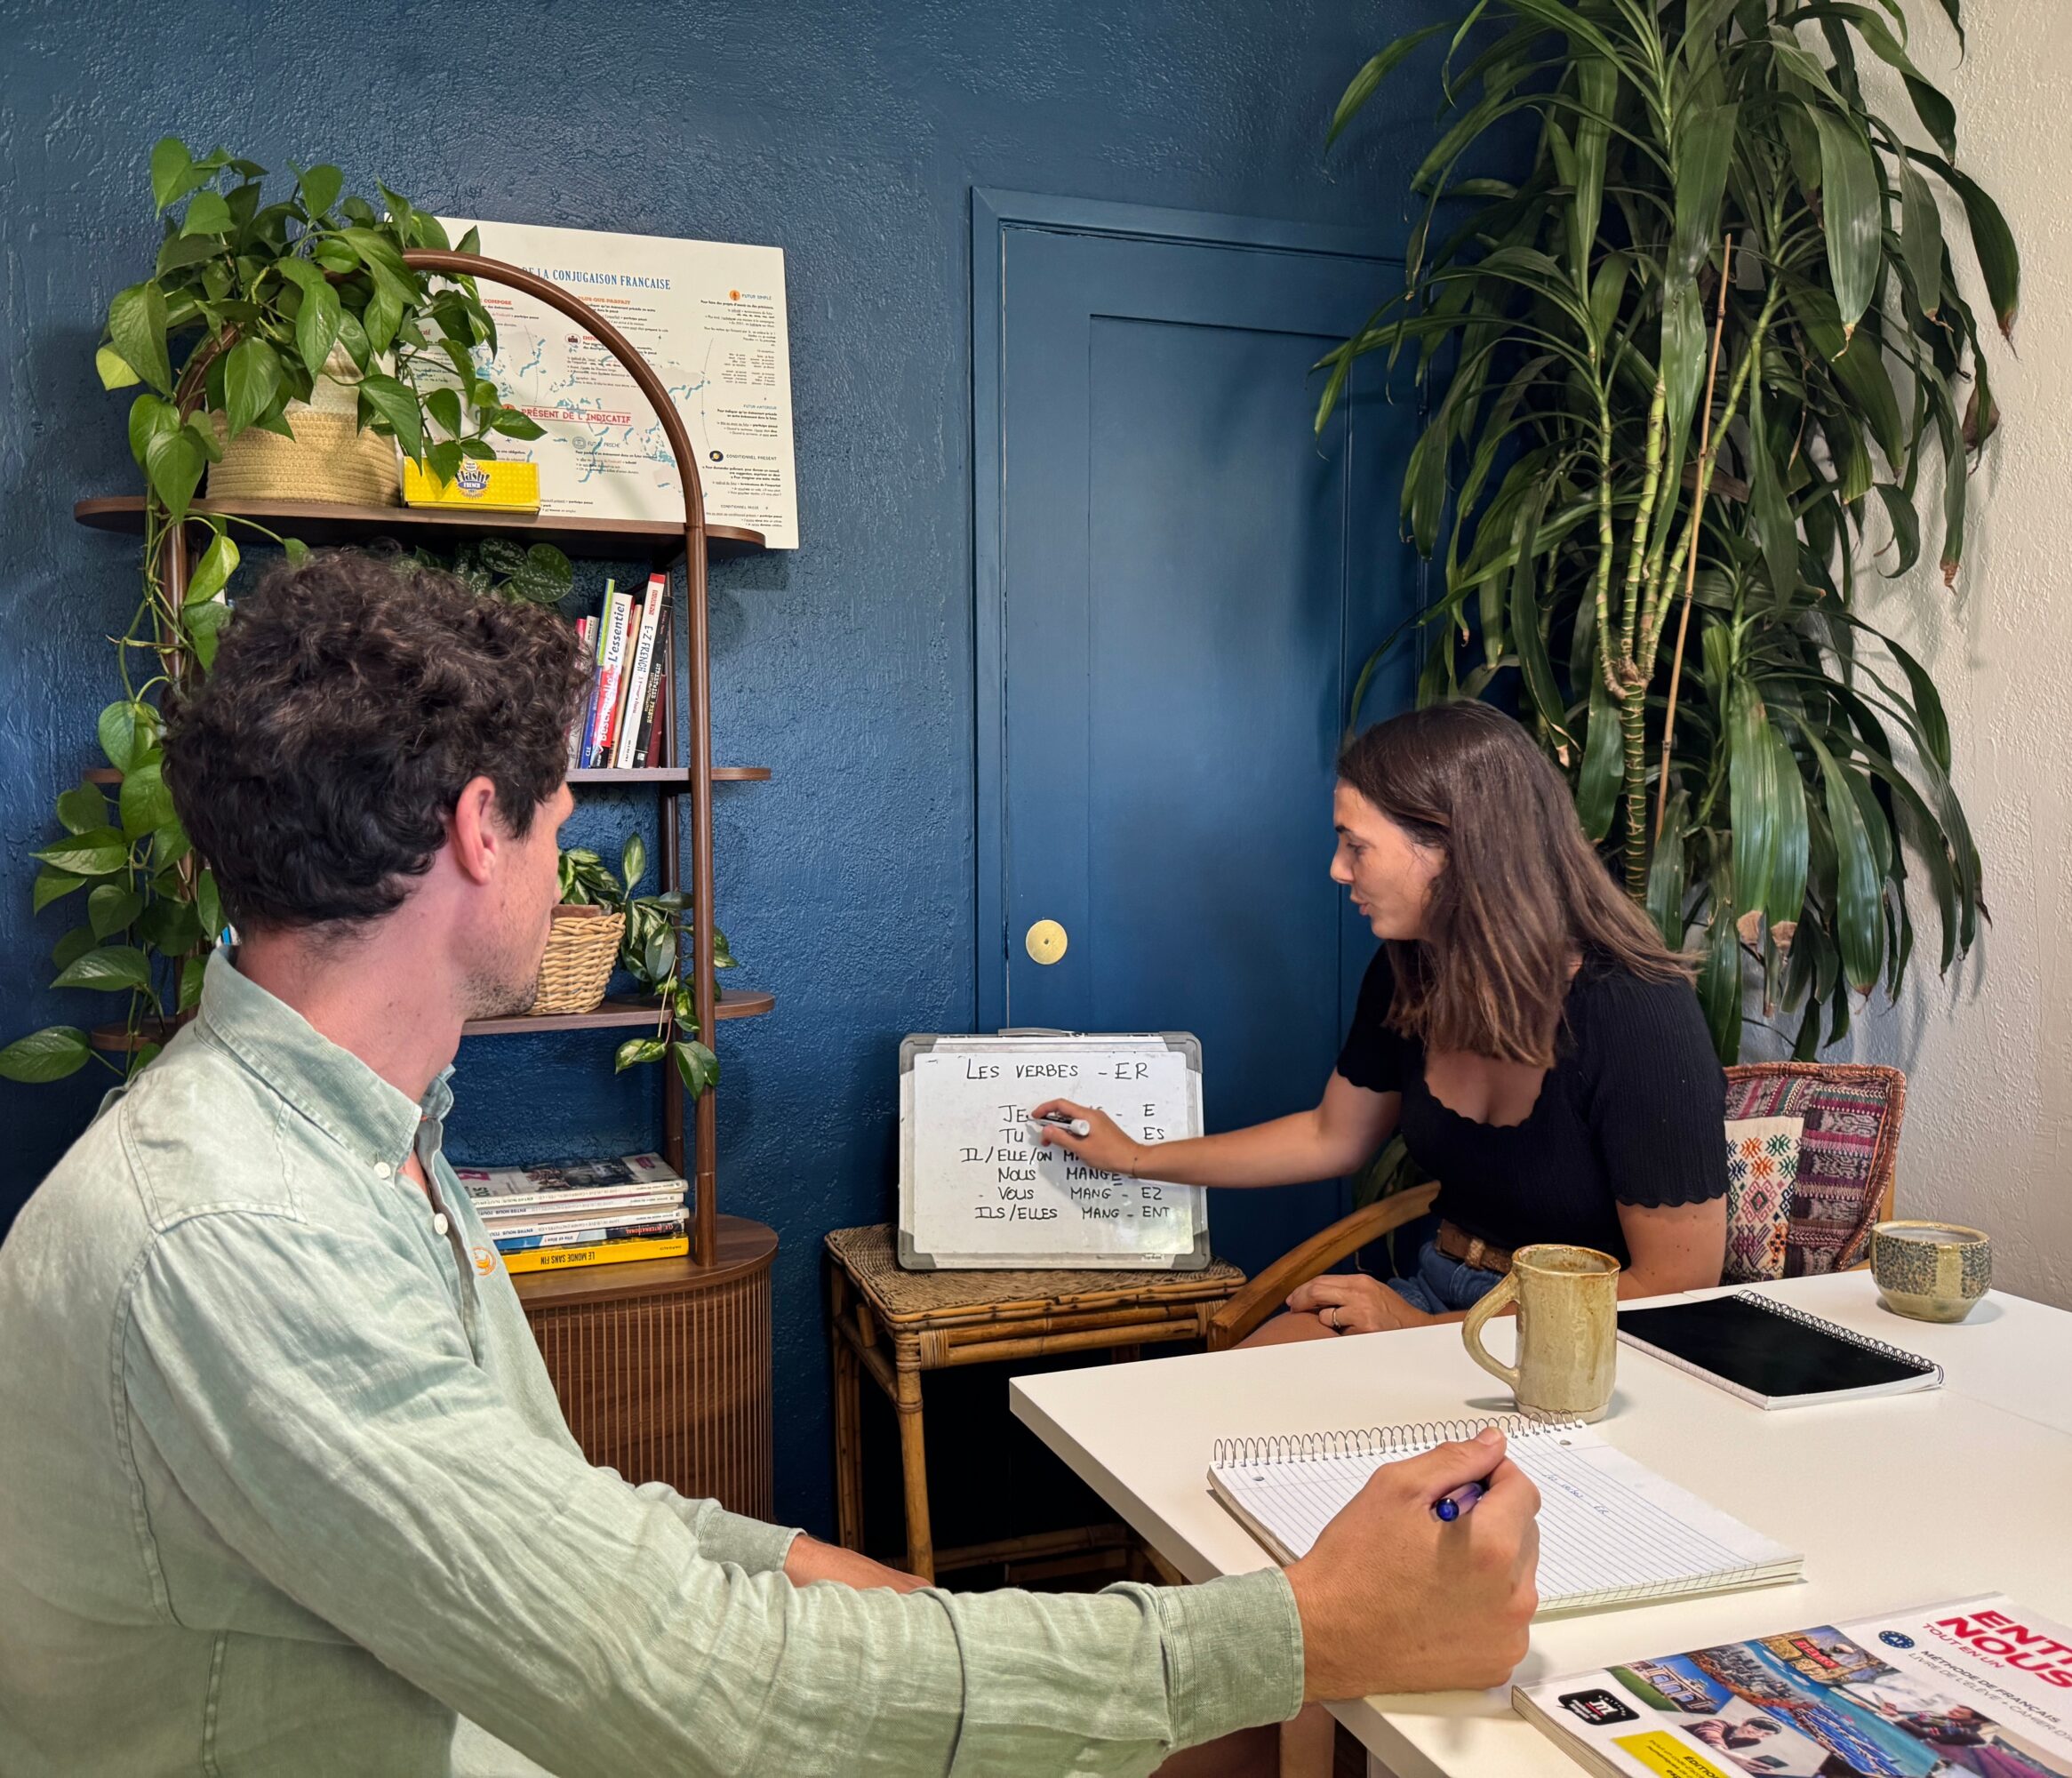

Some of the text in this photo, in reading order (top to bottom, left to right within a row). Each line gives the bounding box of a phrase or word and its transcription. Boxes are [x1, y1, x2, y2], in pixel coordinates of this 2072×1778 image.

[553, 269, 618, 285] CONJUGAISON
[563, 412, 574, 420] DE
[578, 412, 632, 424] LINDICATIF
[455, 471, 491, 484] Flash!
[608, 602, 626, 663] L'essentiel
[643, 626, 653, 641] E-Z
[636, 642, 650, 673] FRENCH
[966, 1058, 1000, 1080] LES
[1016, 1063, 1079, 1078] VERBES
[998, 1104, 1028, 1123] JE
[1143, 1103, 1156, 1117] E
[999, 1126, 1165, 1144] TU ES
[1069, 1187, 1111, 1200] MANG
[974, 1205, 1058, 1221] ILS/ELLES
[1081, 1206, 1120, 1220] MANG
[1141, 1205, 1171, 1219] ENT
[626, 1226, 662, 1235] INTERNATIONAL
[540, 1252, 596, 1265] LE MONDE SANS FIN
[1923, 1623, 2005, 1669] TOUT EN UN
[1968, 1609, 2072, 1666] ENT
[1934, 1616, 2072, 1688] NOUS
[1908, 1653, 1940, 1670] LIVRE
[1940, 1670, 1957, 1679] DE
[2009, 1705, 2056, 1731] CAHIER
[1921, 1650, 2061, 1723] MÉTHODE DE FRANÇAIS
